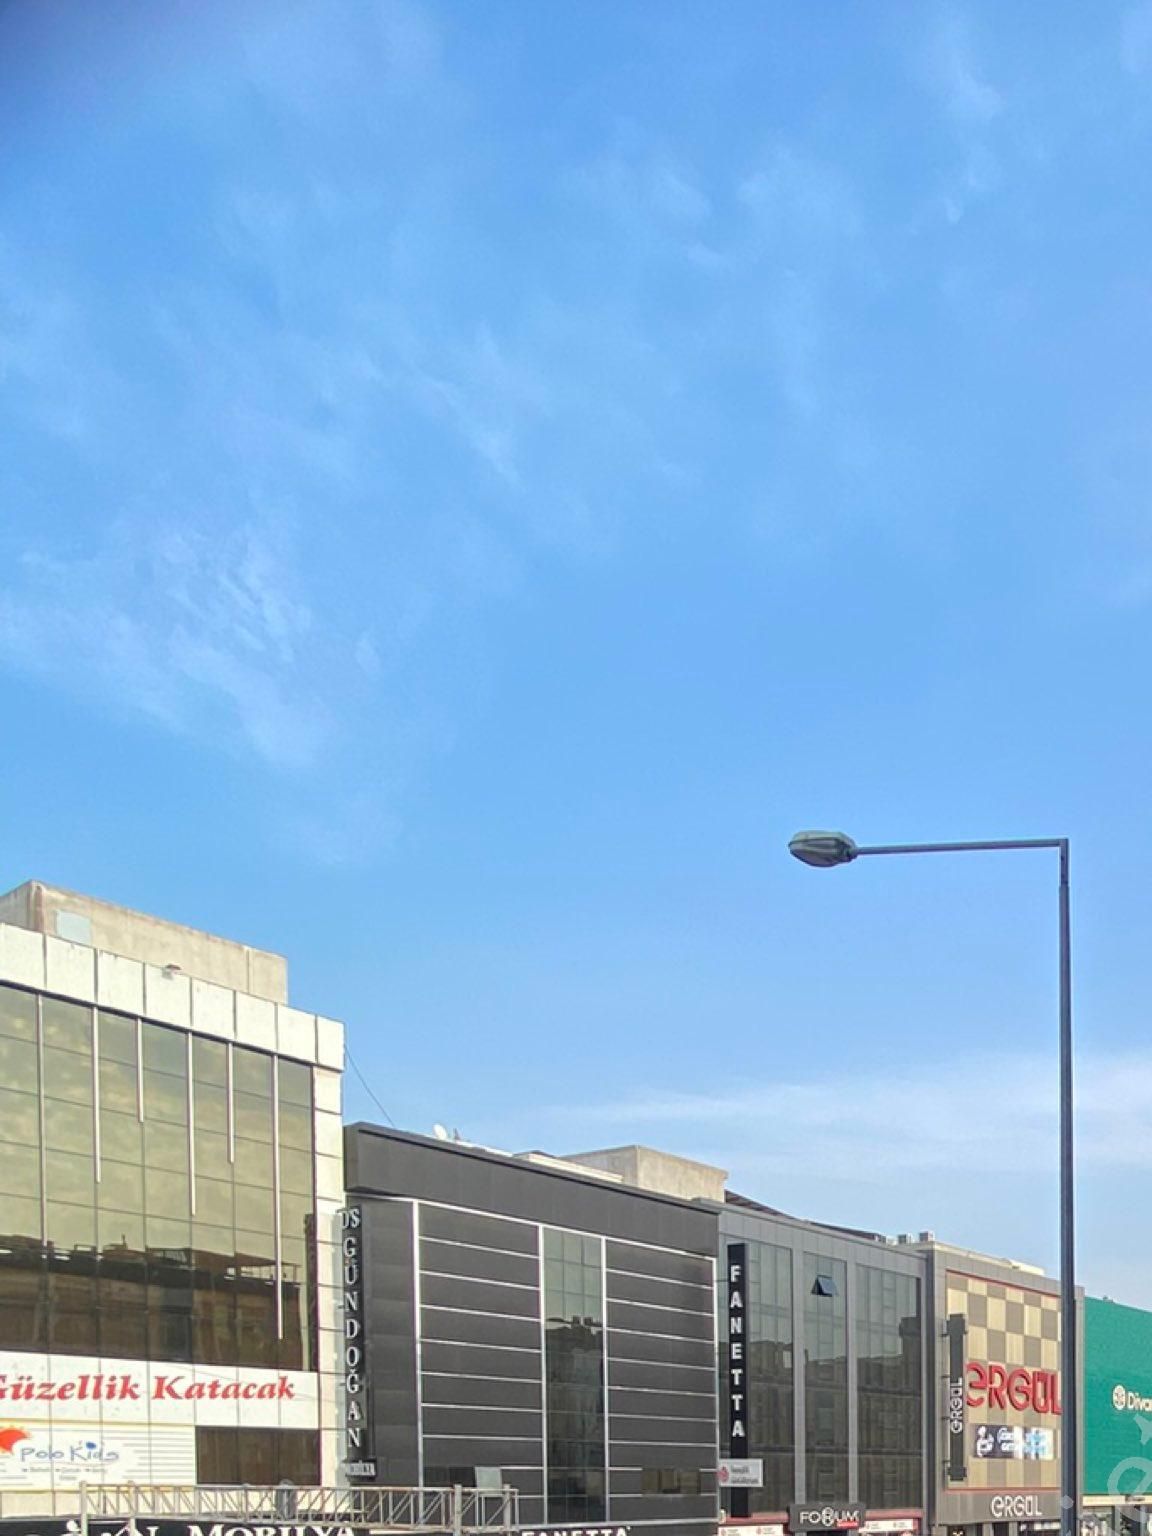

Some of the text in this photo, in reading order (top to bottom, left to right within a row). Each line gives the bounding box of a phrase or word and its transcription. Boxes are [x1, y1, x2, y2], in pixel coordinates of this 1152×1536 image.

[0, 1374, 296, 1401] üzellik Katacak
[730, 1264, 746, 1438] FANETTA
